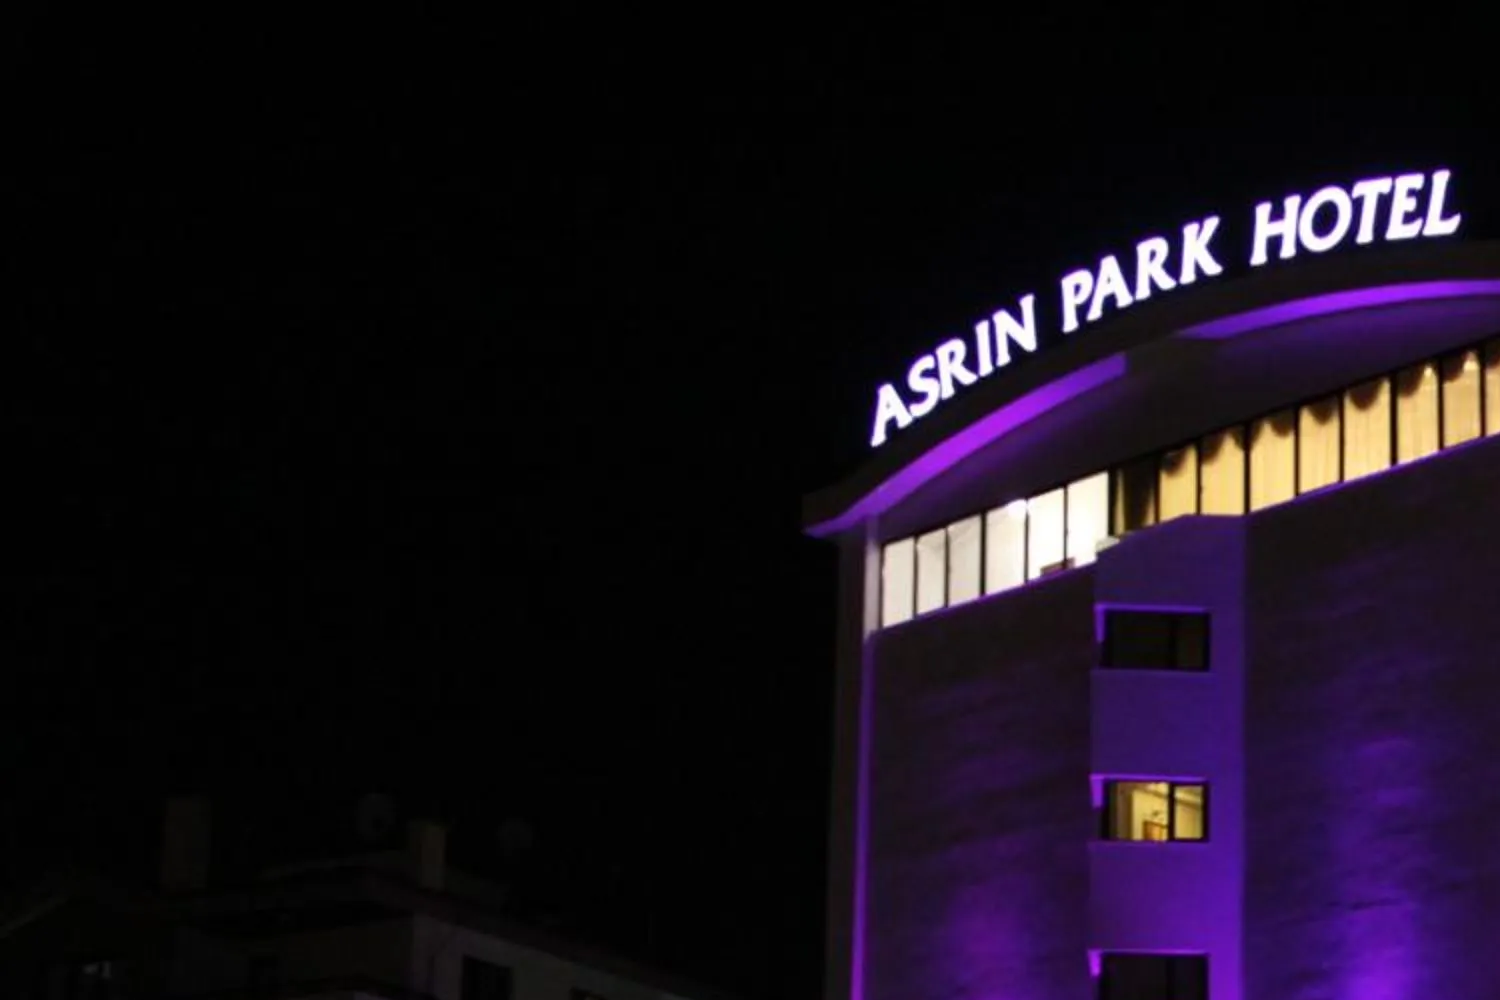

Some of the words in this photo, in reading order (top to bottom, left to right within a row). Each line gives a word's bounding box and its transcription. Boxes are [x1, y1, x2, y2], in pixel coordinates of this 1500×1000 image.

[869, 292, 1038, 448] ASRIN
[1060, 215, 1225, 334] PARK
[1248, 168, 1462, 267] HOTEL
